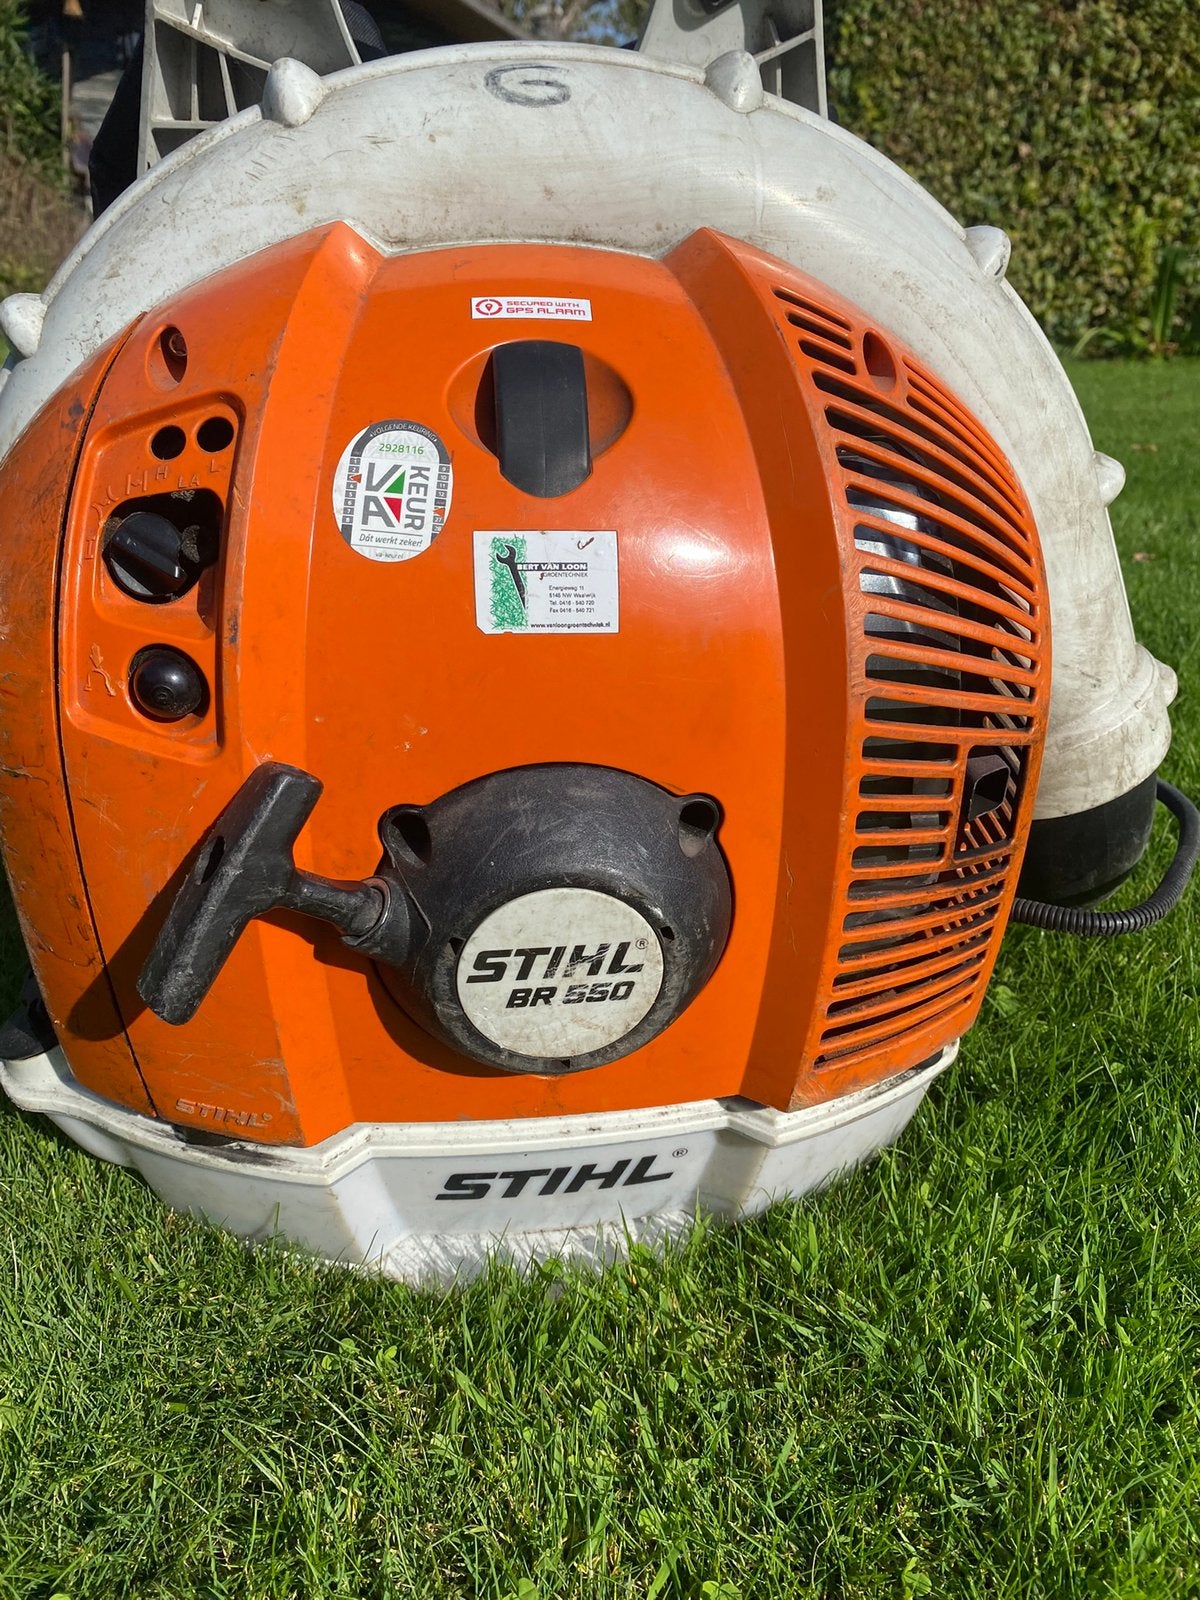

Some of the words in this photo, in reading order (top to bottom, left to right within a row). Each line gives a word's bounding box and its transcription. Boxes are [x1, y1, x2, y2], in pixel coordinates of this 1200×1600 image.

[537, 308, 586, 316] ALARM
[379, 443, 425, 455] 2928116
[404, 465, 431, 531] KEUR
[375, 536, 398, 545] werkt
[399, 538, 423, 547] zeker!
[517, 563, 540, 571] BERT
[540, 563, 559, 571] VAN
[561, 563, 587, 571] LOON
[505, 986, 557, 1008] BR
[562, 980, 635, 1005] 550
